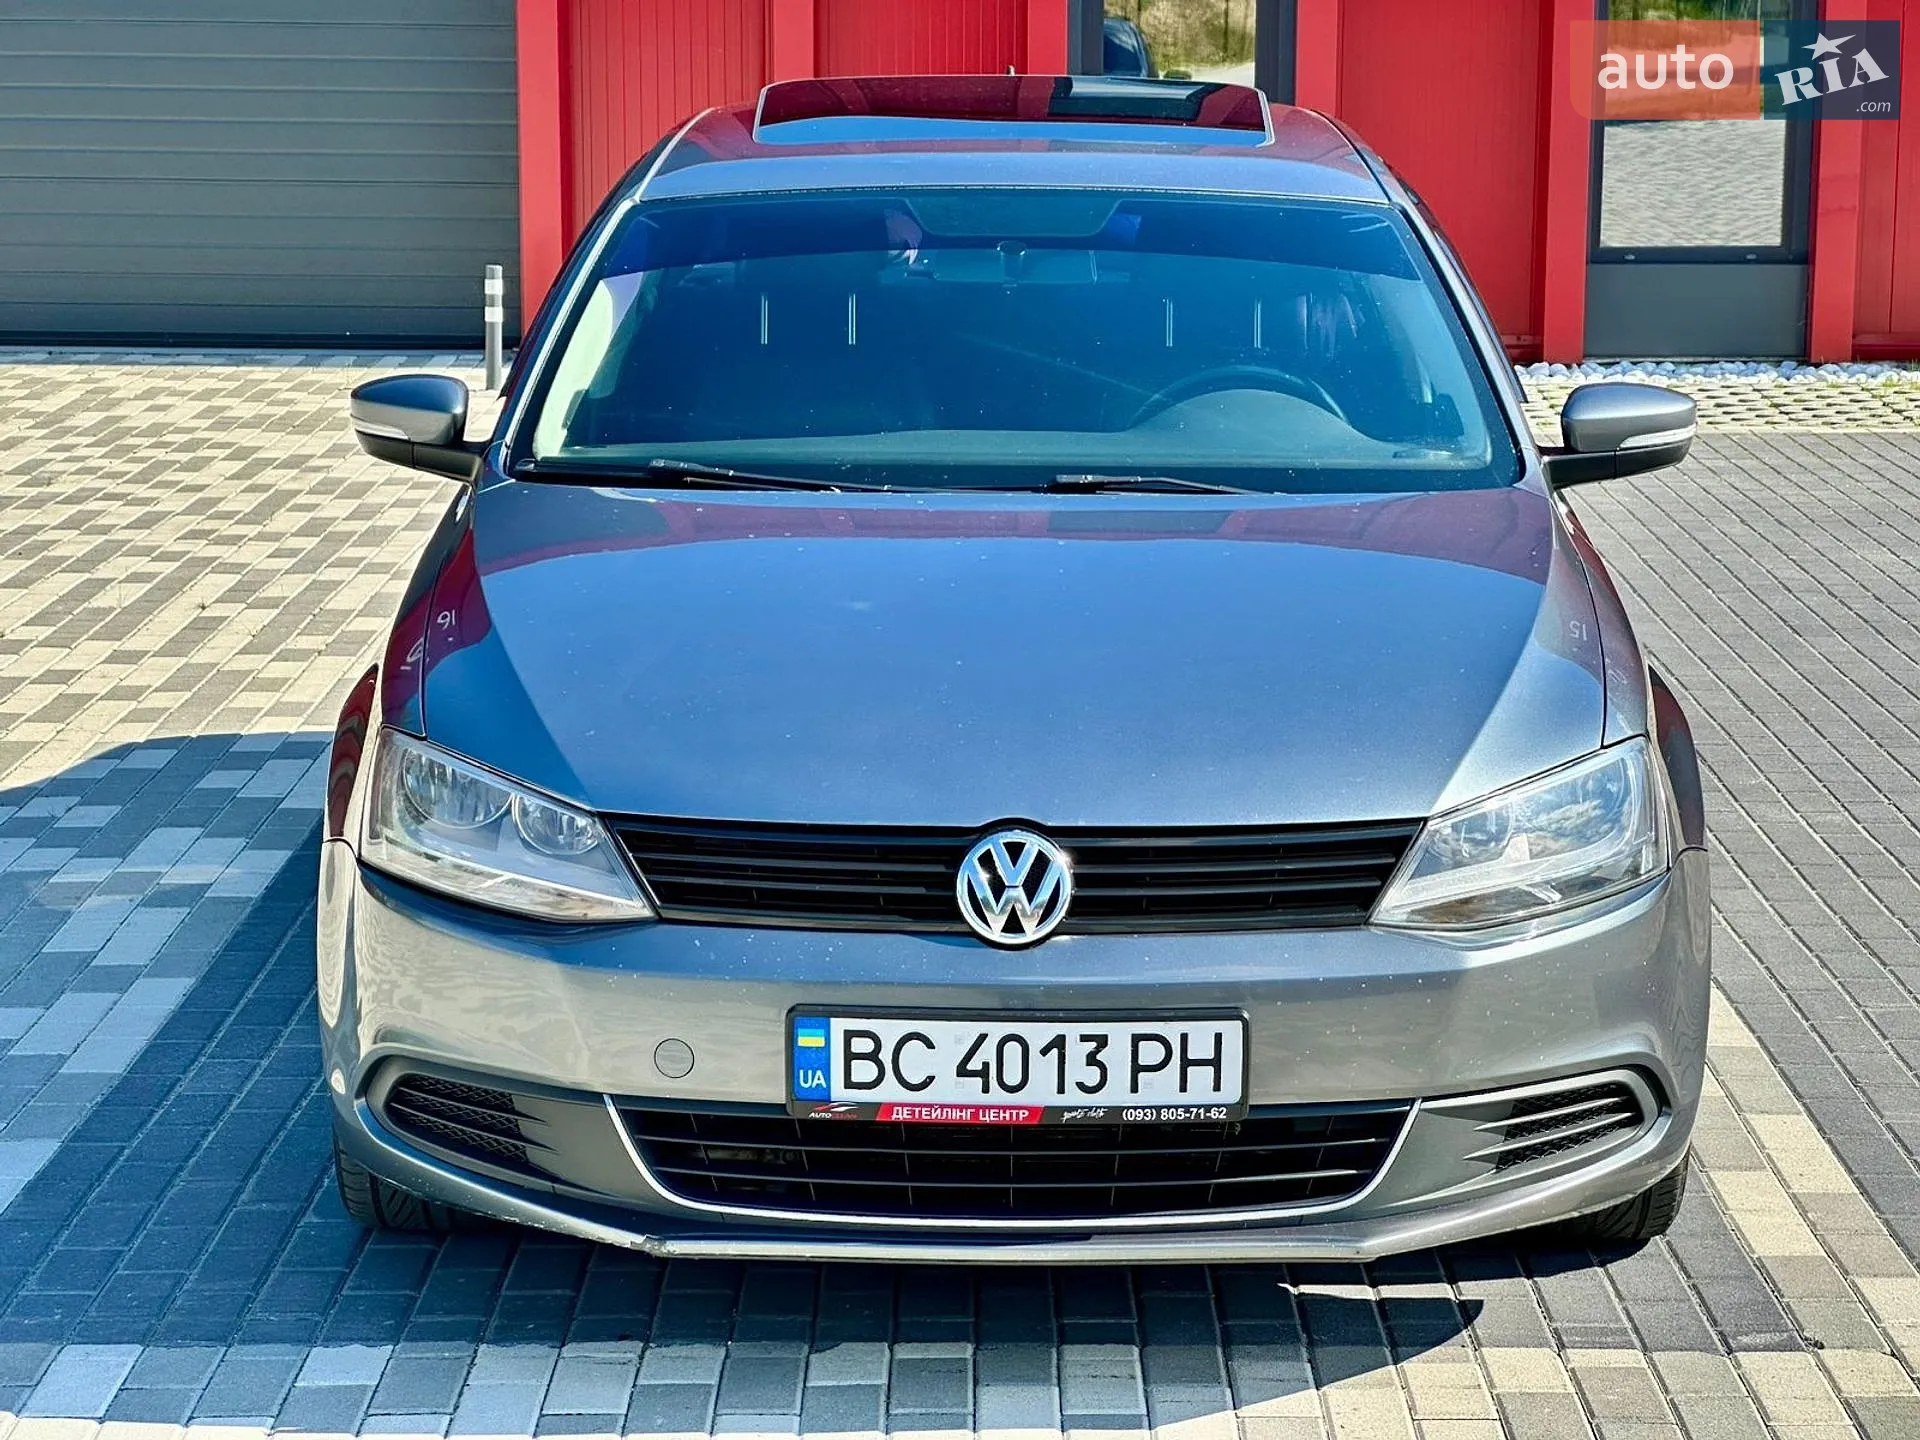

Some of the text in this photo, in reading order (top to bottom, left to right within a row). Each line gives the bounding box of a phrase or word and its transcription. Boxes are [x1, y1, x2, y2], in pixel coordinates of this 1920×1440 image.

[960, 833, 1068, 942] VW
[843, 1029, 1222, 1095] BC 4013 PH
[799, 1069, 827, 1089] UA
[891, 1106, 1030, 1123] ДЕТЕЙЛІНГ ЦЕНТР
[1122, 1108, 1156, 1121] (093)
[1160, 1107, 1227, 1120] 805-71-62
